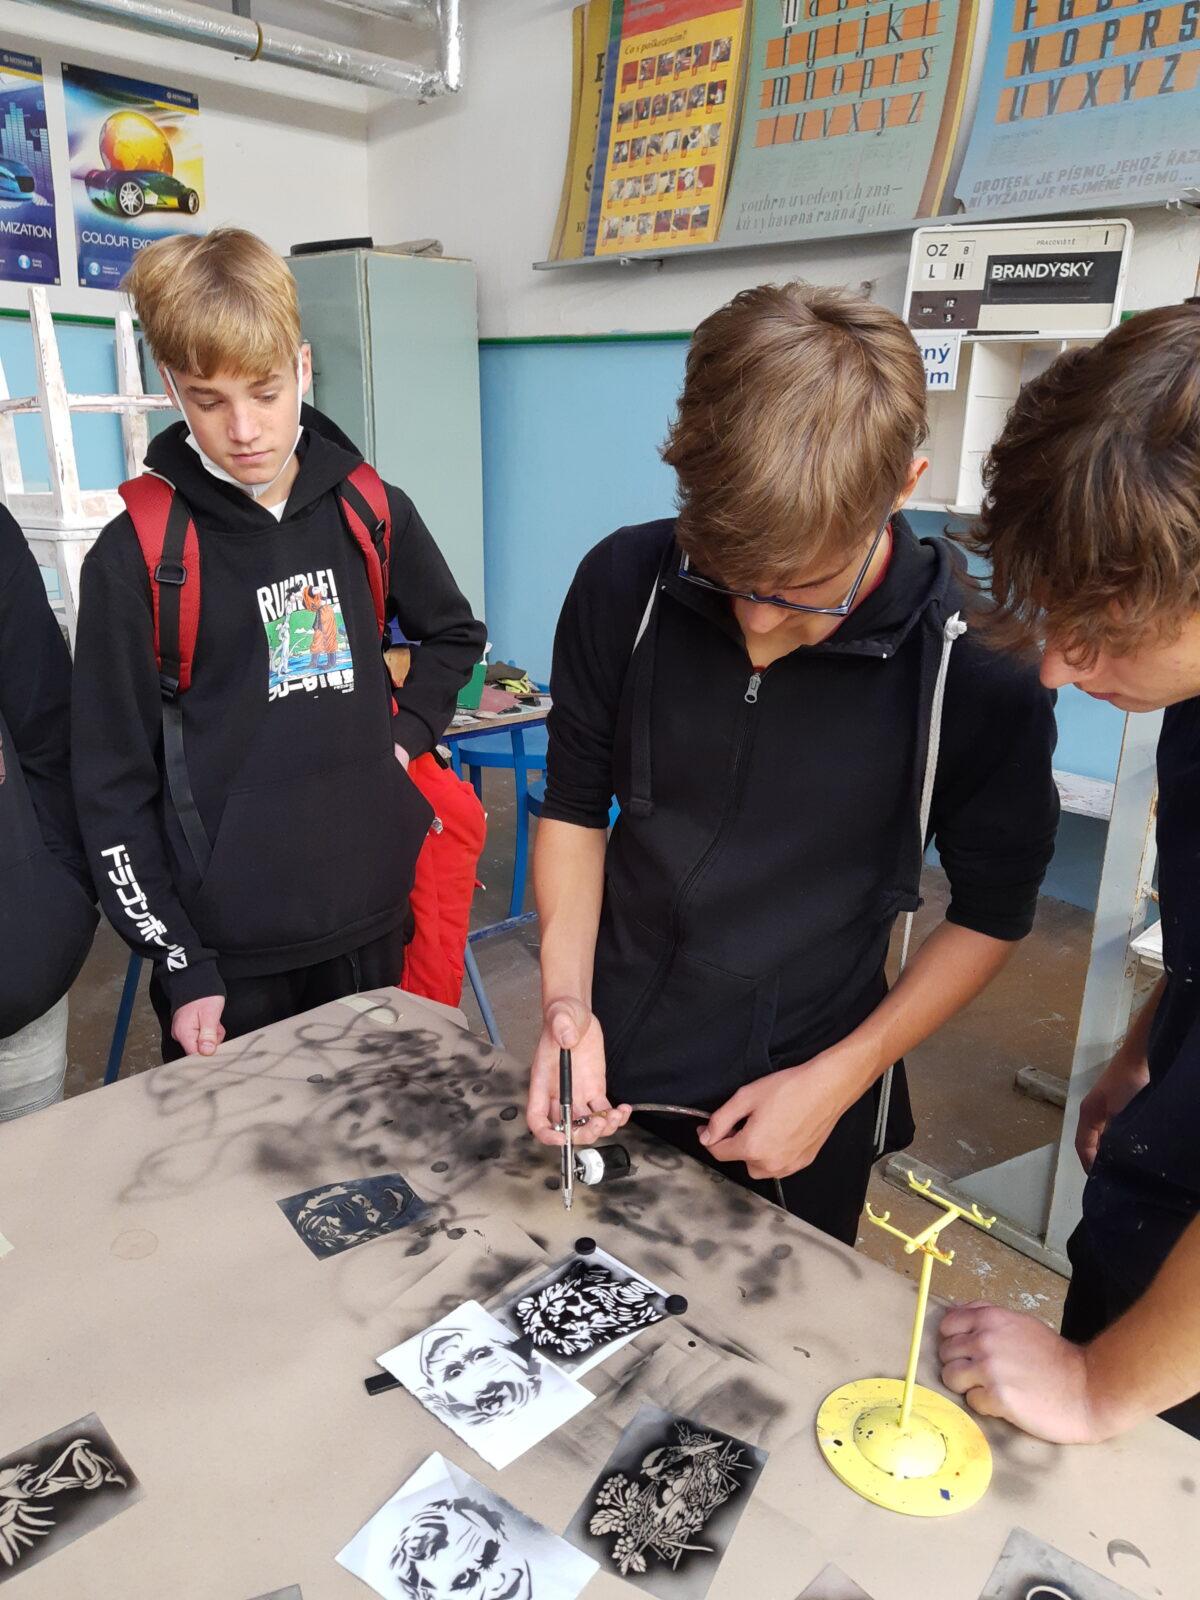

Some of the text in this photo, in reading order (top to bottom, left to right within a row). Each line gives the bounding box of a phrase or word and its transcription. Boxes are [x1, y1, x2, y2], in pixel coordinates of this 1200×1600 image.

[82, 231, 129, 248] COLOUR
[926, 243, 949, 257] OZ
[928, 263, 936, 279] L
[920, 342, 951, 364] ný
